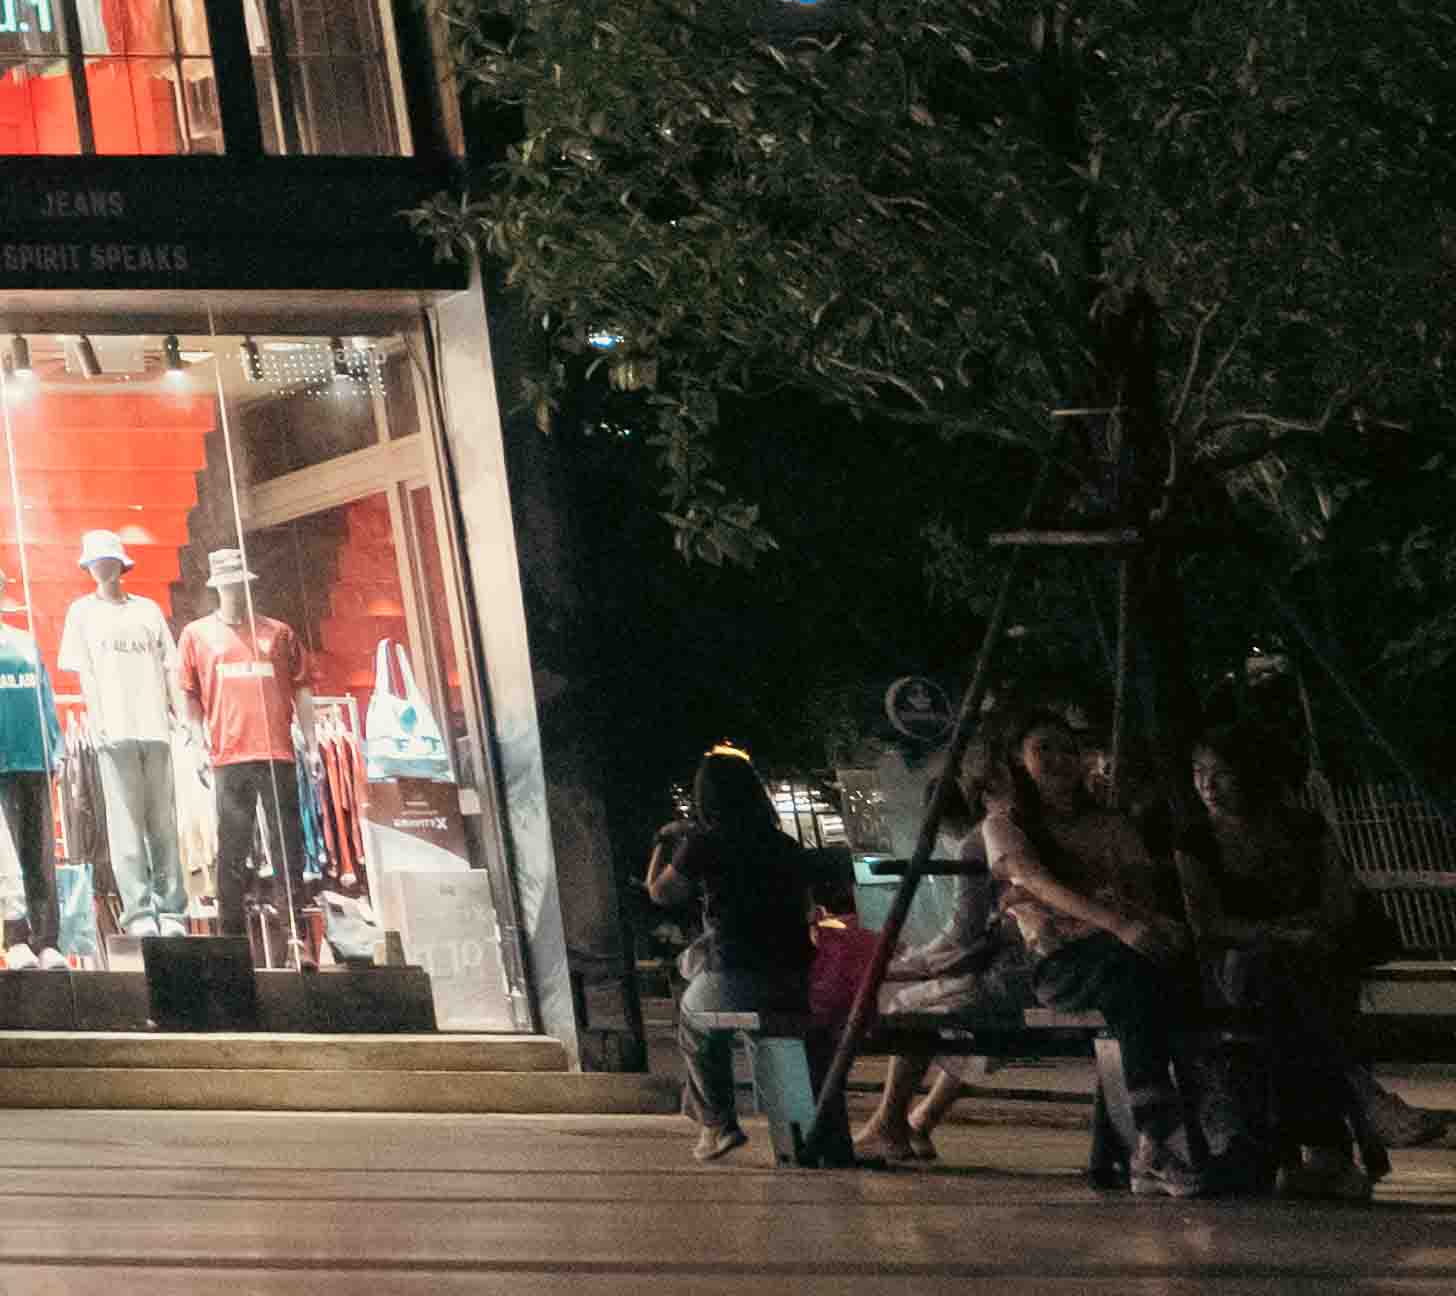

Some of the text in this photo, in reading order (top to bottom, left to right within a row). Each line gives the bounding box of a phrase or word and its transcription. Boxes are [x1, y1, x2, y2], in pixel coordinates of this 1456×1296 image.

[40, 190, 123, 217] JEANS
[3, 245, 80, 273] SPIRIT
[89, 244, 189, 273] SPEAKS
